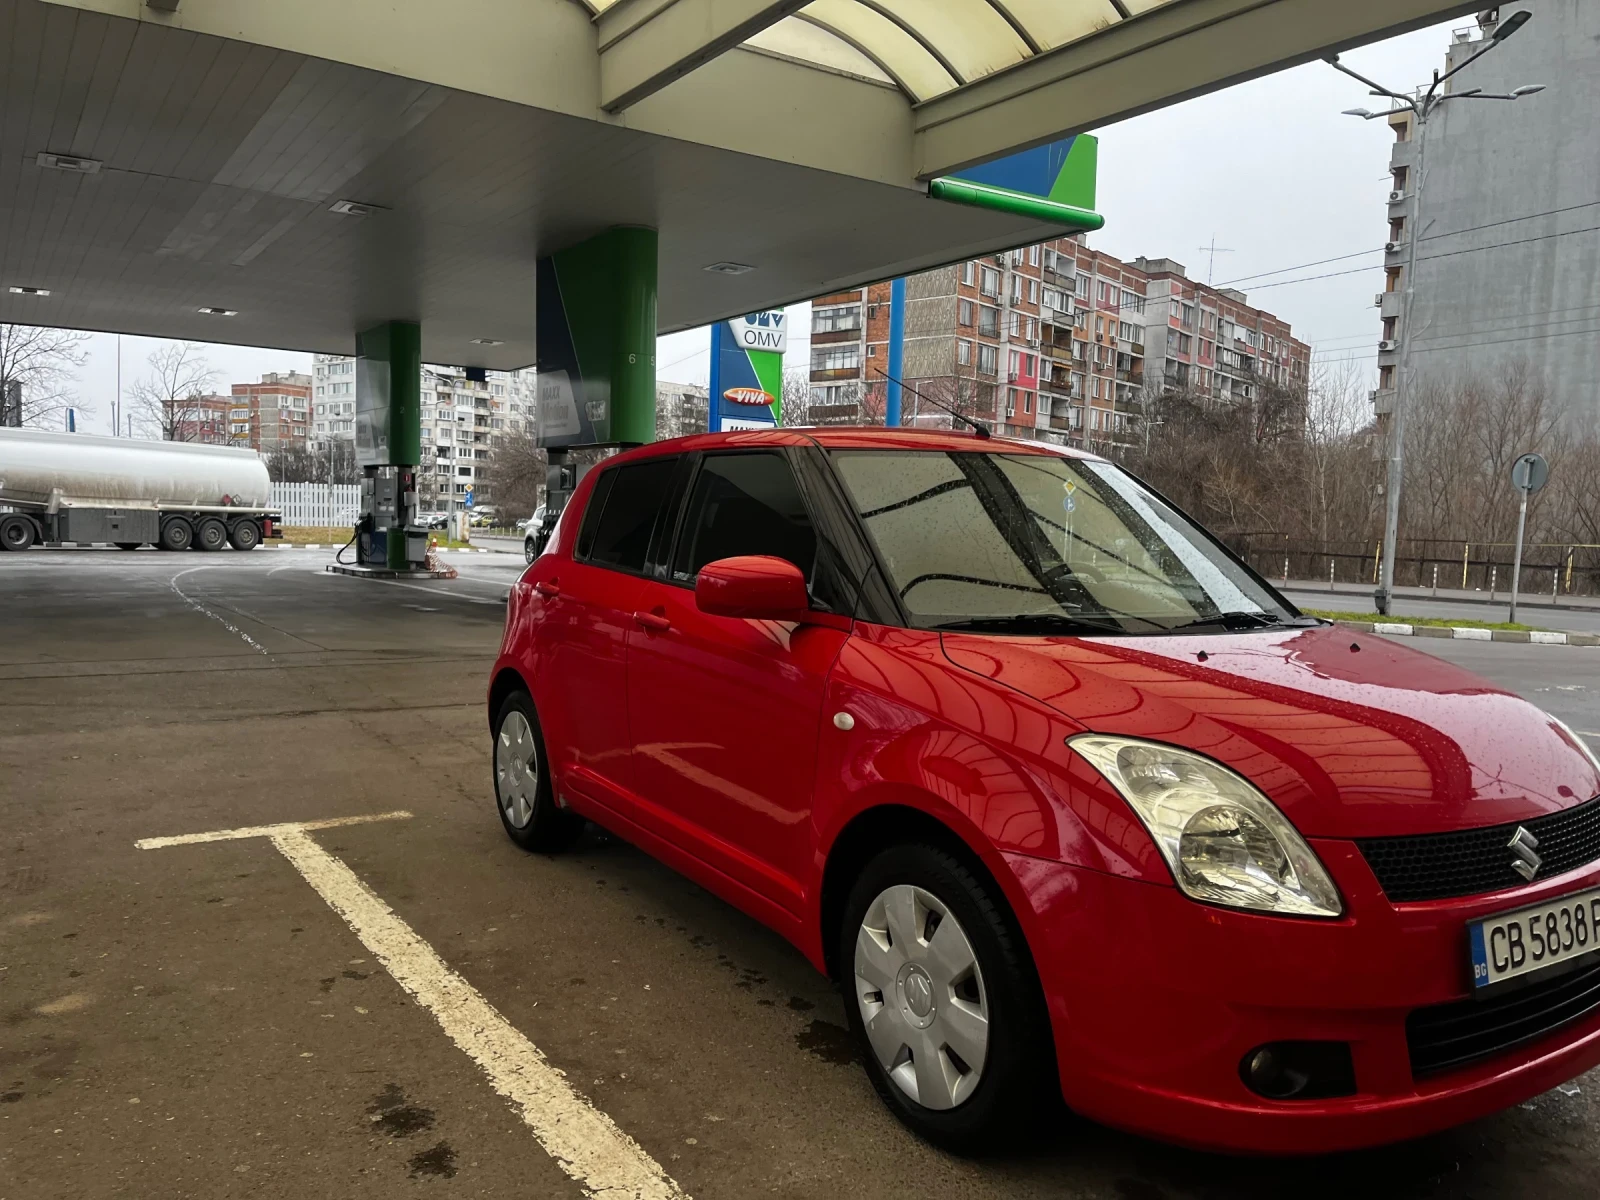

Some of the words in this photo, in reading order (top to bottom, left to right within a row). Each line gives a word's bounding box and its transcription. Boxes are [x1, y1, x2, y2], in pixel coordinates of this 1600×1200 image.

[744, 330, 782, 347] OMV
[628, 353, 636, 364] 6
[736, 390, 766, 404] VIVA
[1474, 963, 1487, 978] BG
